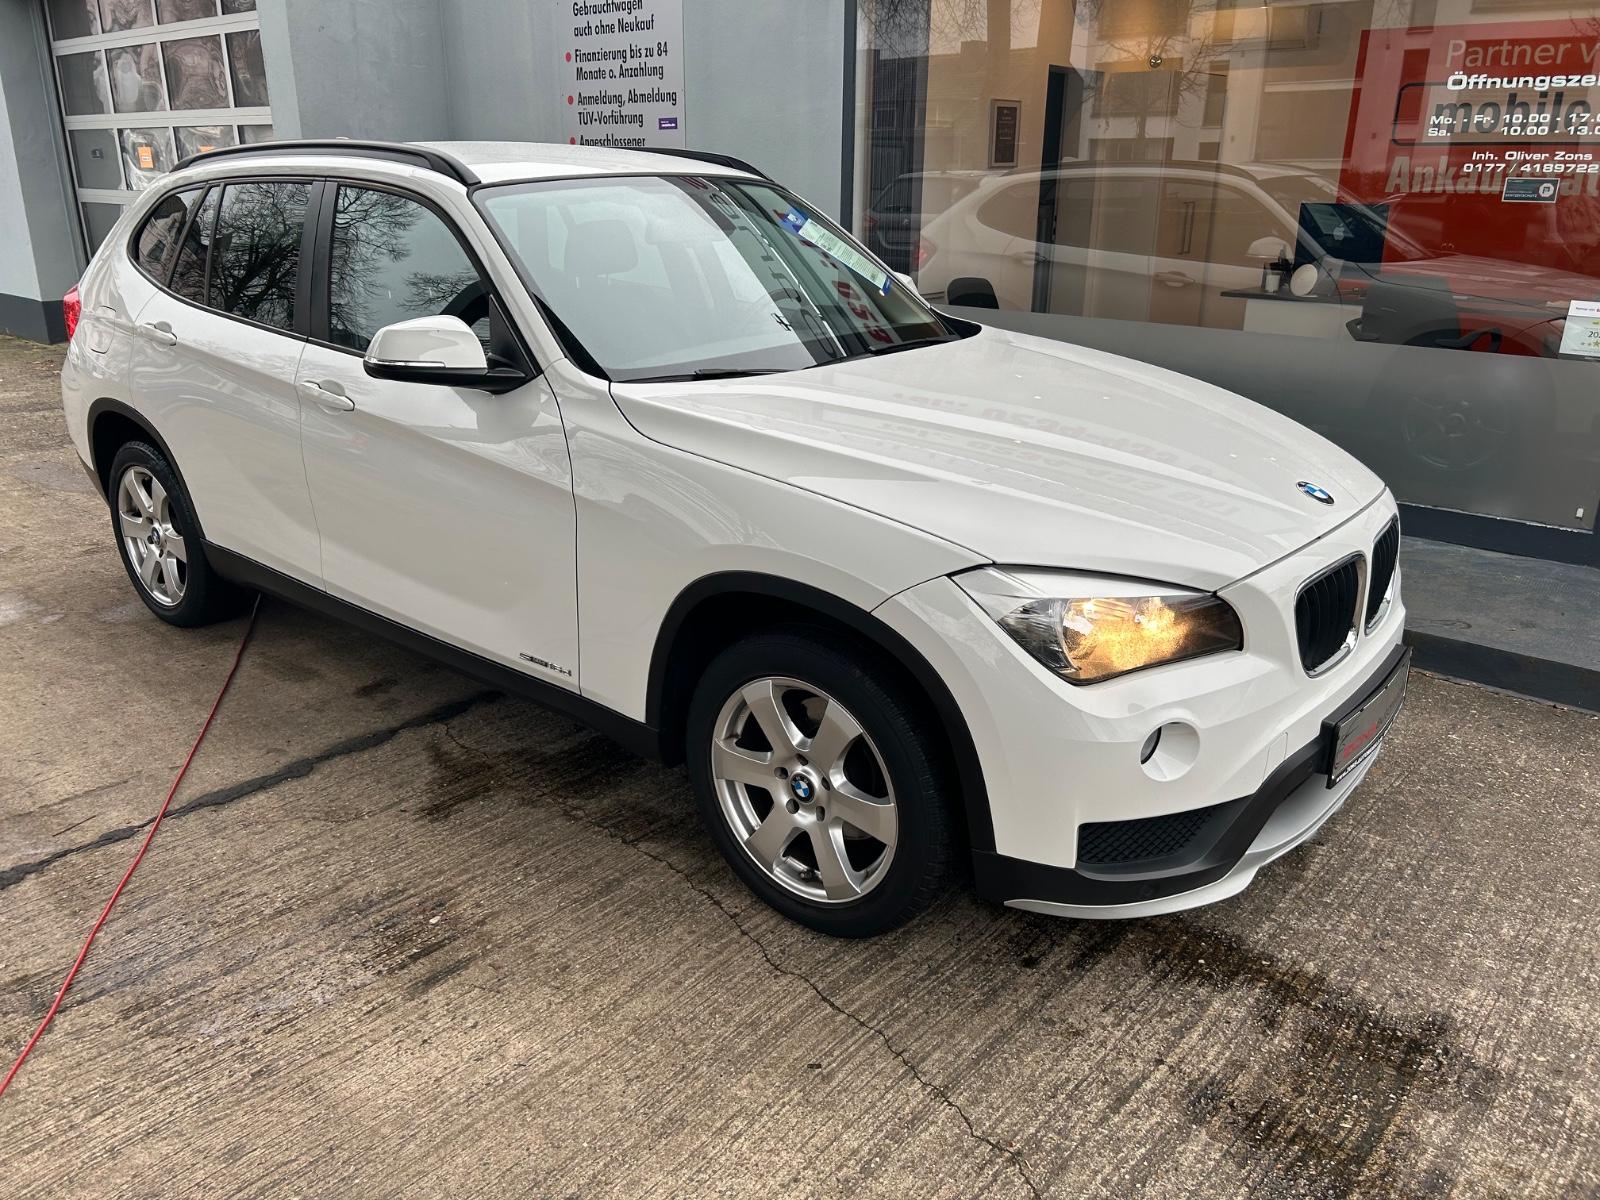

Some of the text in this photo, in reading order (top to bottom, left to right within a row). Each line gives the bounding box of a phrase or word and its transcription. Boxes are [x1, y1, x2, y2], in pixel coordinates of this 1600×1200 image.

[572, 0, 643, 16] Gebrauchtwagen
[574, 13, 655, 37] auch ohne Neukauf
[574, 41, 668, 63] Finanzierung bis zu 84
[1446, 39, 1572, 68] Partner
[576, 61, 664, 81] Monate o. Anzahlung
[1446, 71, 1600, 91] Öffnungsze
[577, 87, 677, 108] Anmeldung, Abmeldung
[578, 108, 644, 128] TÜV-Vorführung
[1429, 115, 1457, 125] Mo.
[1473, 114, 1495, 124] Fr.
[1502, 113, 1550, 123] 10.00
[1427, 127, 1451, 137] Sa.
[1500, 126, 1549, 136] 10.00
[1472, 151, 1593, 161] Inh. Oliver Zons
[1463, 163, 1506, 173] 0177
[1520, 163, 1600, 174] 4189722
